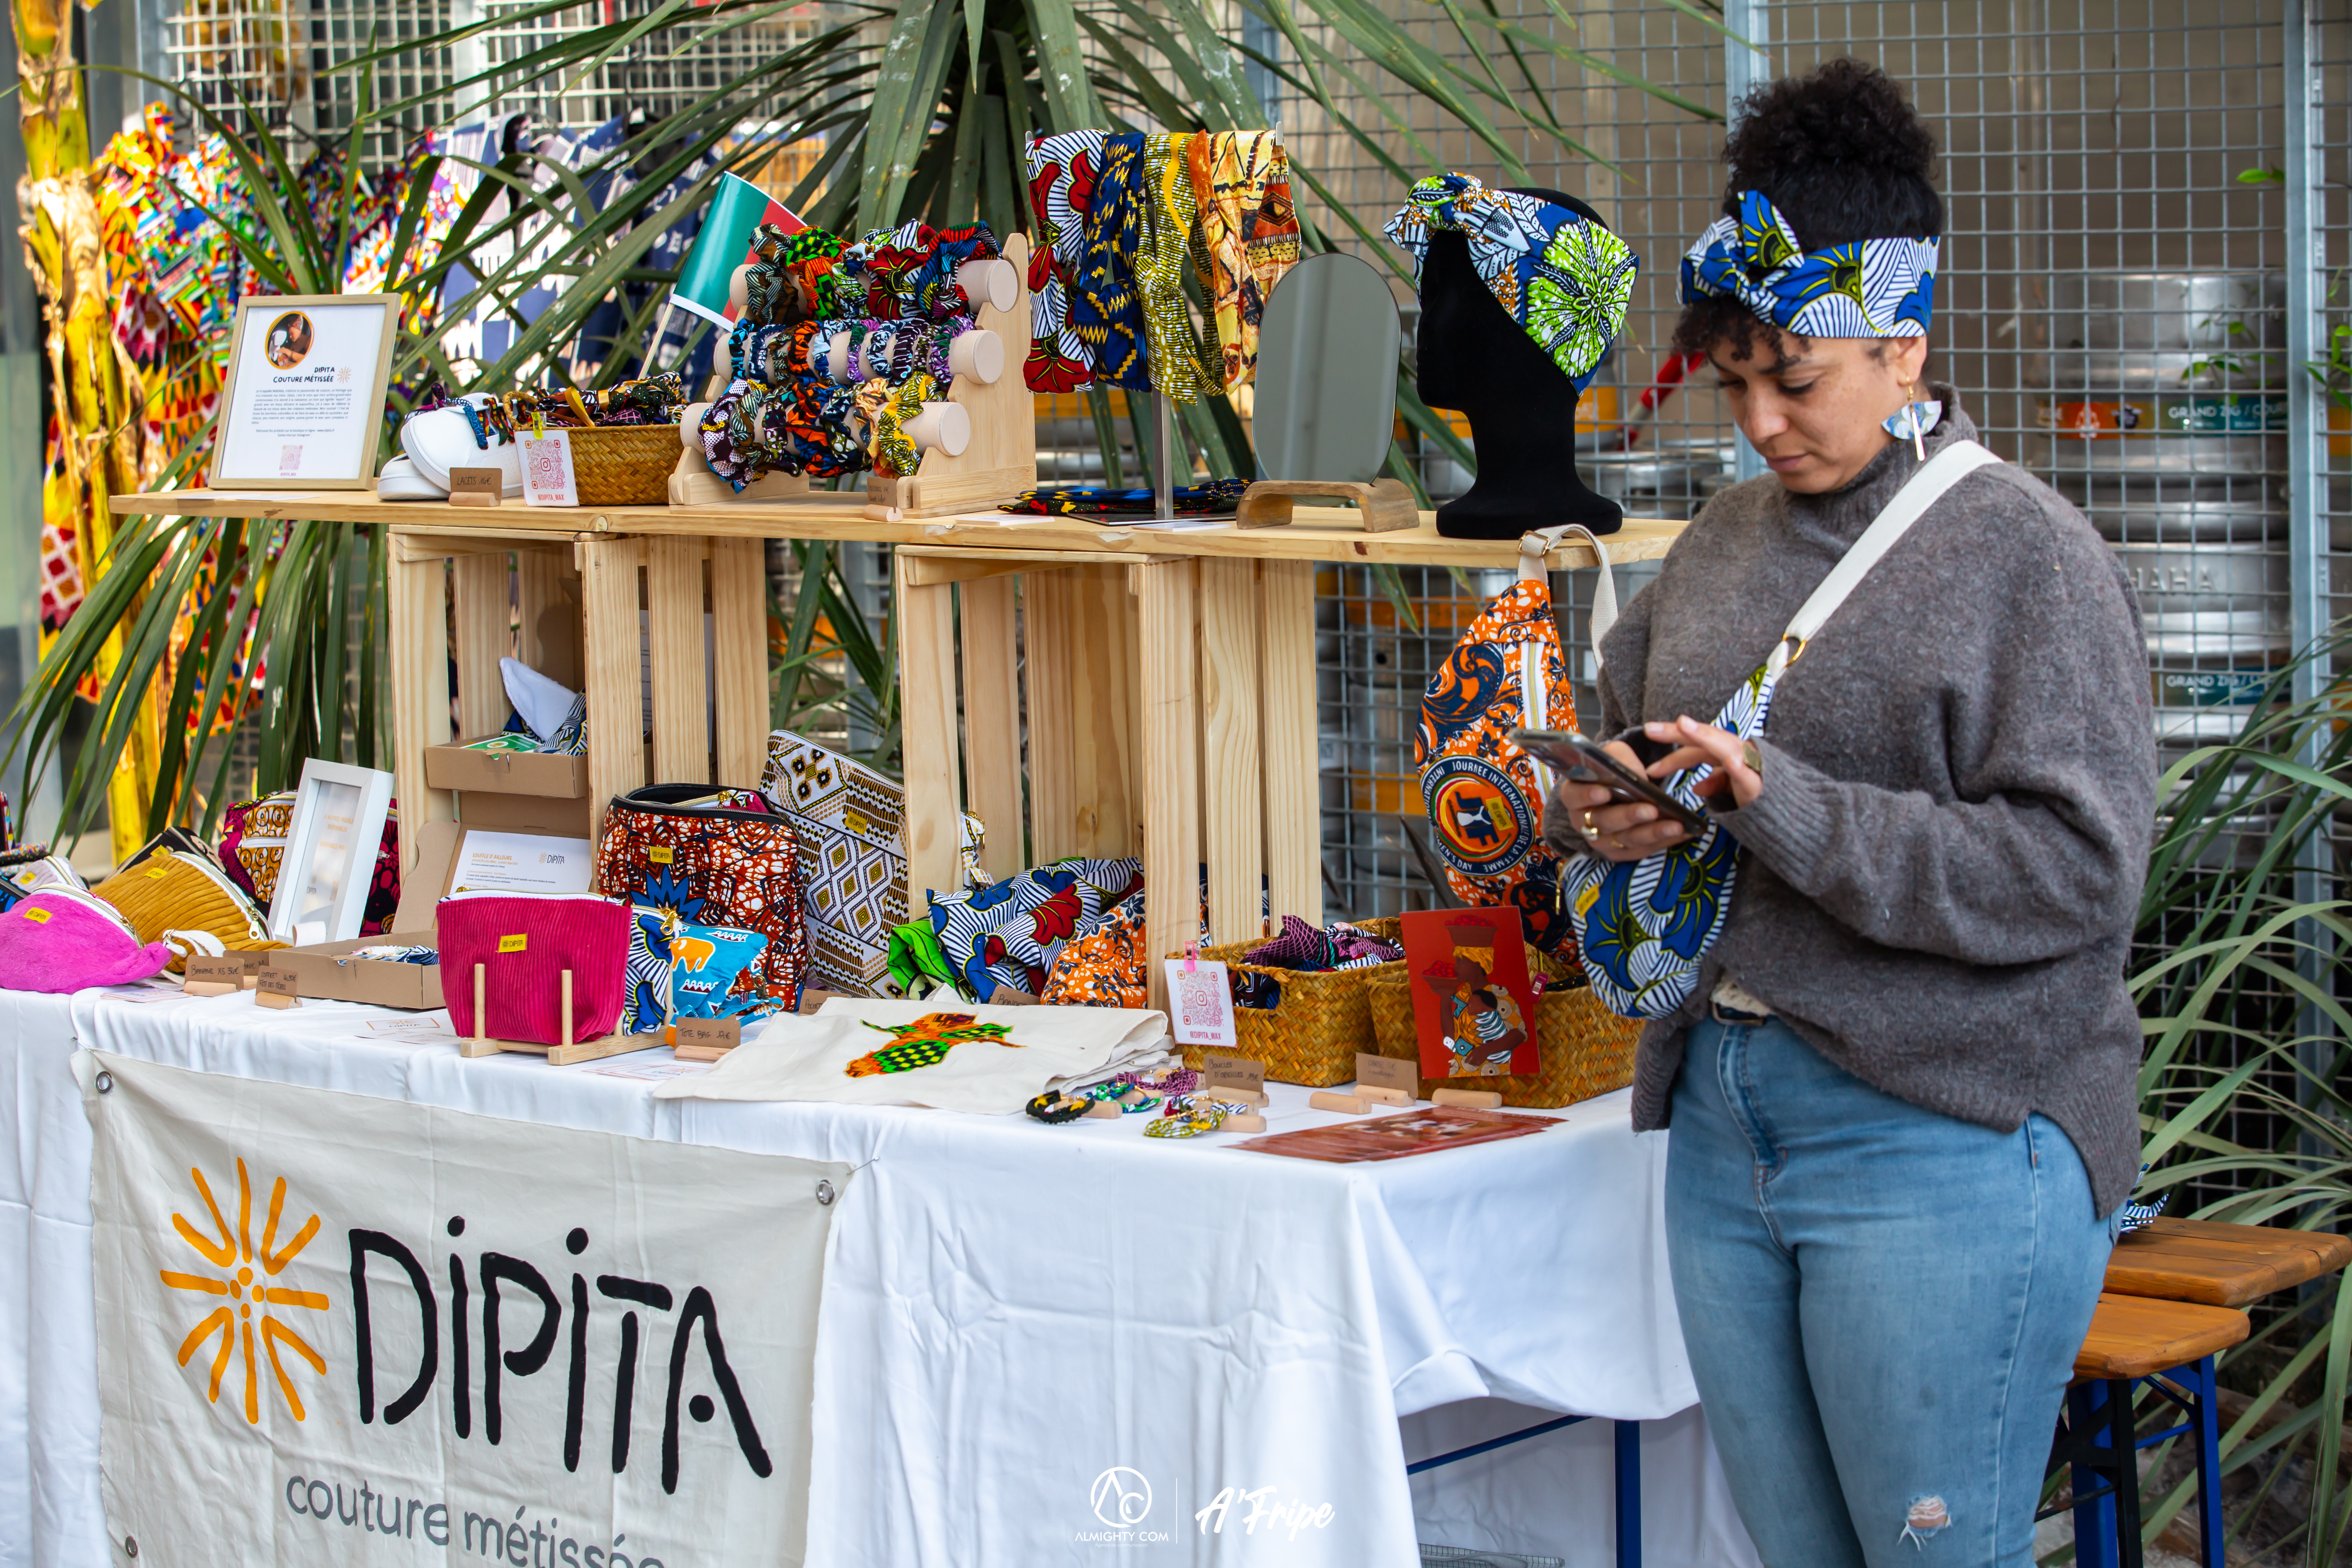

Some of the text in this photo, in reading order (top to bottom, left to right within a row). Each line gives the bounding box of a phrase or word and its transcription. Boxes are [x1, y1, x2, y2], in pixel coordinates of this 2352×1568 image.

[304, 374, 334, 383] MÉTISSÉE
[457, 477, 492, 485] LACETS 14€
[1452, 761, 1488, 777] JOURNEE
[1457, 859, 1473, 871] DAY
[191, 964, 214, 976] BANANE
[227, 967, 239, 975] 34€
[679, 1028, 731, 1040] TOTE BAG 17€
[1190, 1031, 1221, 1040] @DIPITA_WAX
[286, 1475, 666, 1568] couture métissé
